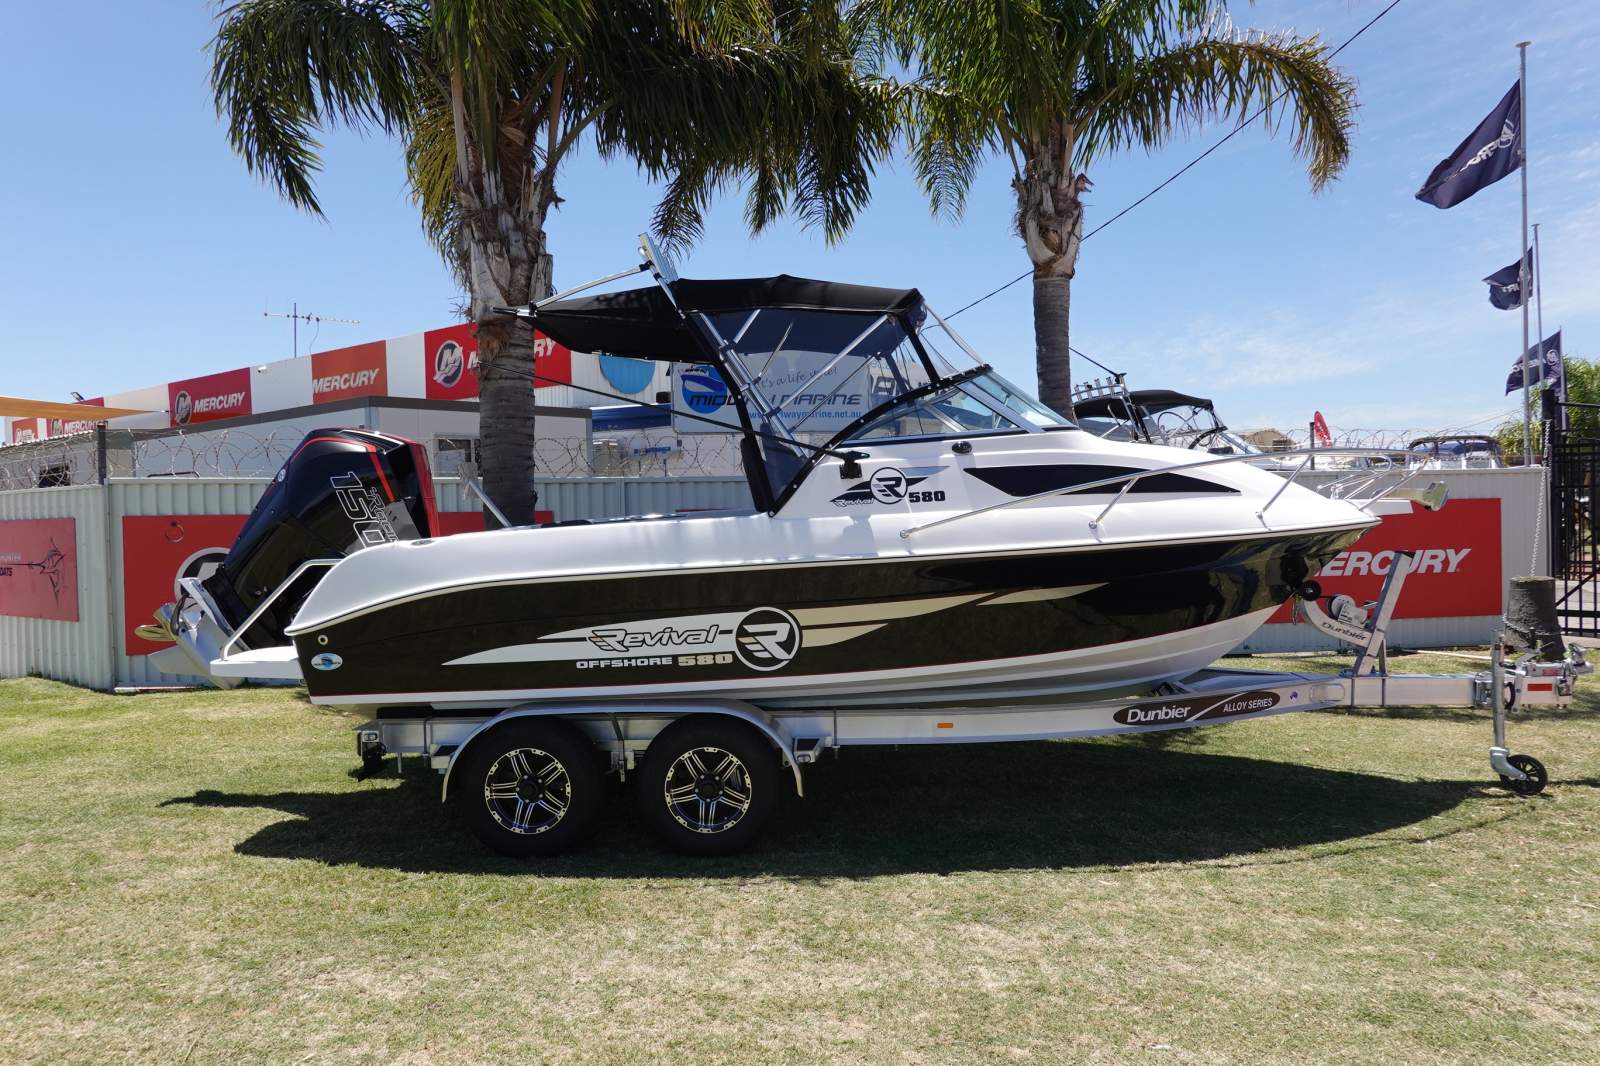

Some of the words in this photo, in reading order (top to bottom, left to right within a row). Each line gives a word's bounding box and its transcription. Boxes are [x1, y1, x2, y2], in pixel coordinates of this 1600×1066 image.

[312, 368, 379, 394] MERCURY
[194, 392, 246, 414] MERCURY
[908, 491, 946, 503] 580
[588, 624, 719, 652] Revival
[576, 656, 673, 669] OFFSHORE
[678, 653, 734, 667] 580
[1126, 705, 1191, 723] Dunbier
[1223, 701, 1248, 713] ALLOY
[1247, 697, 1273, 710] SERIES
